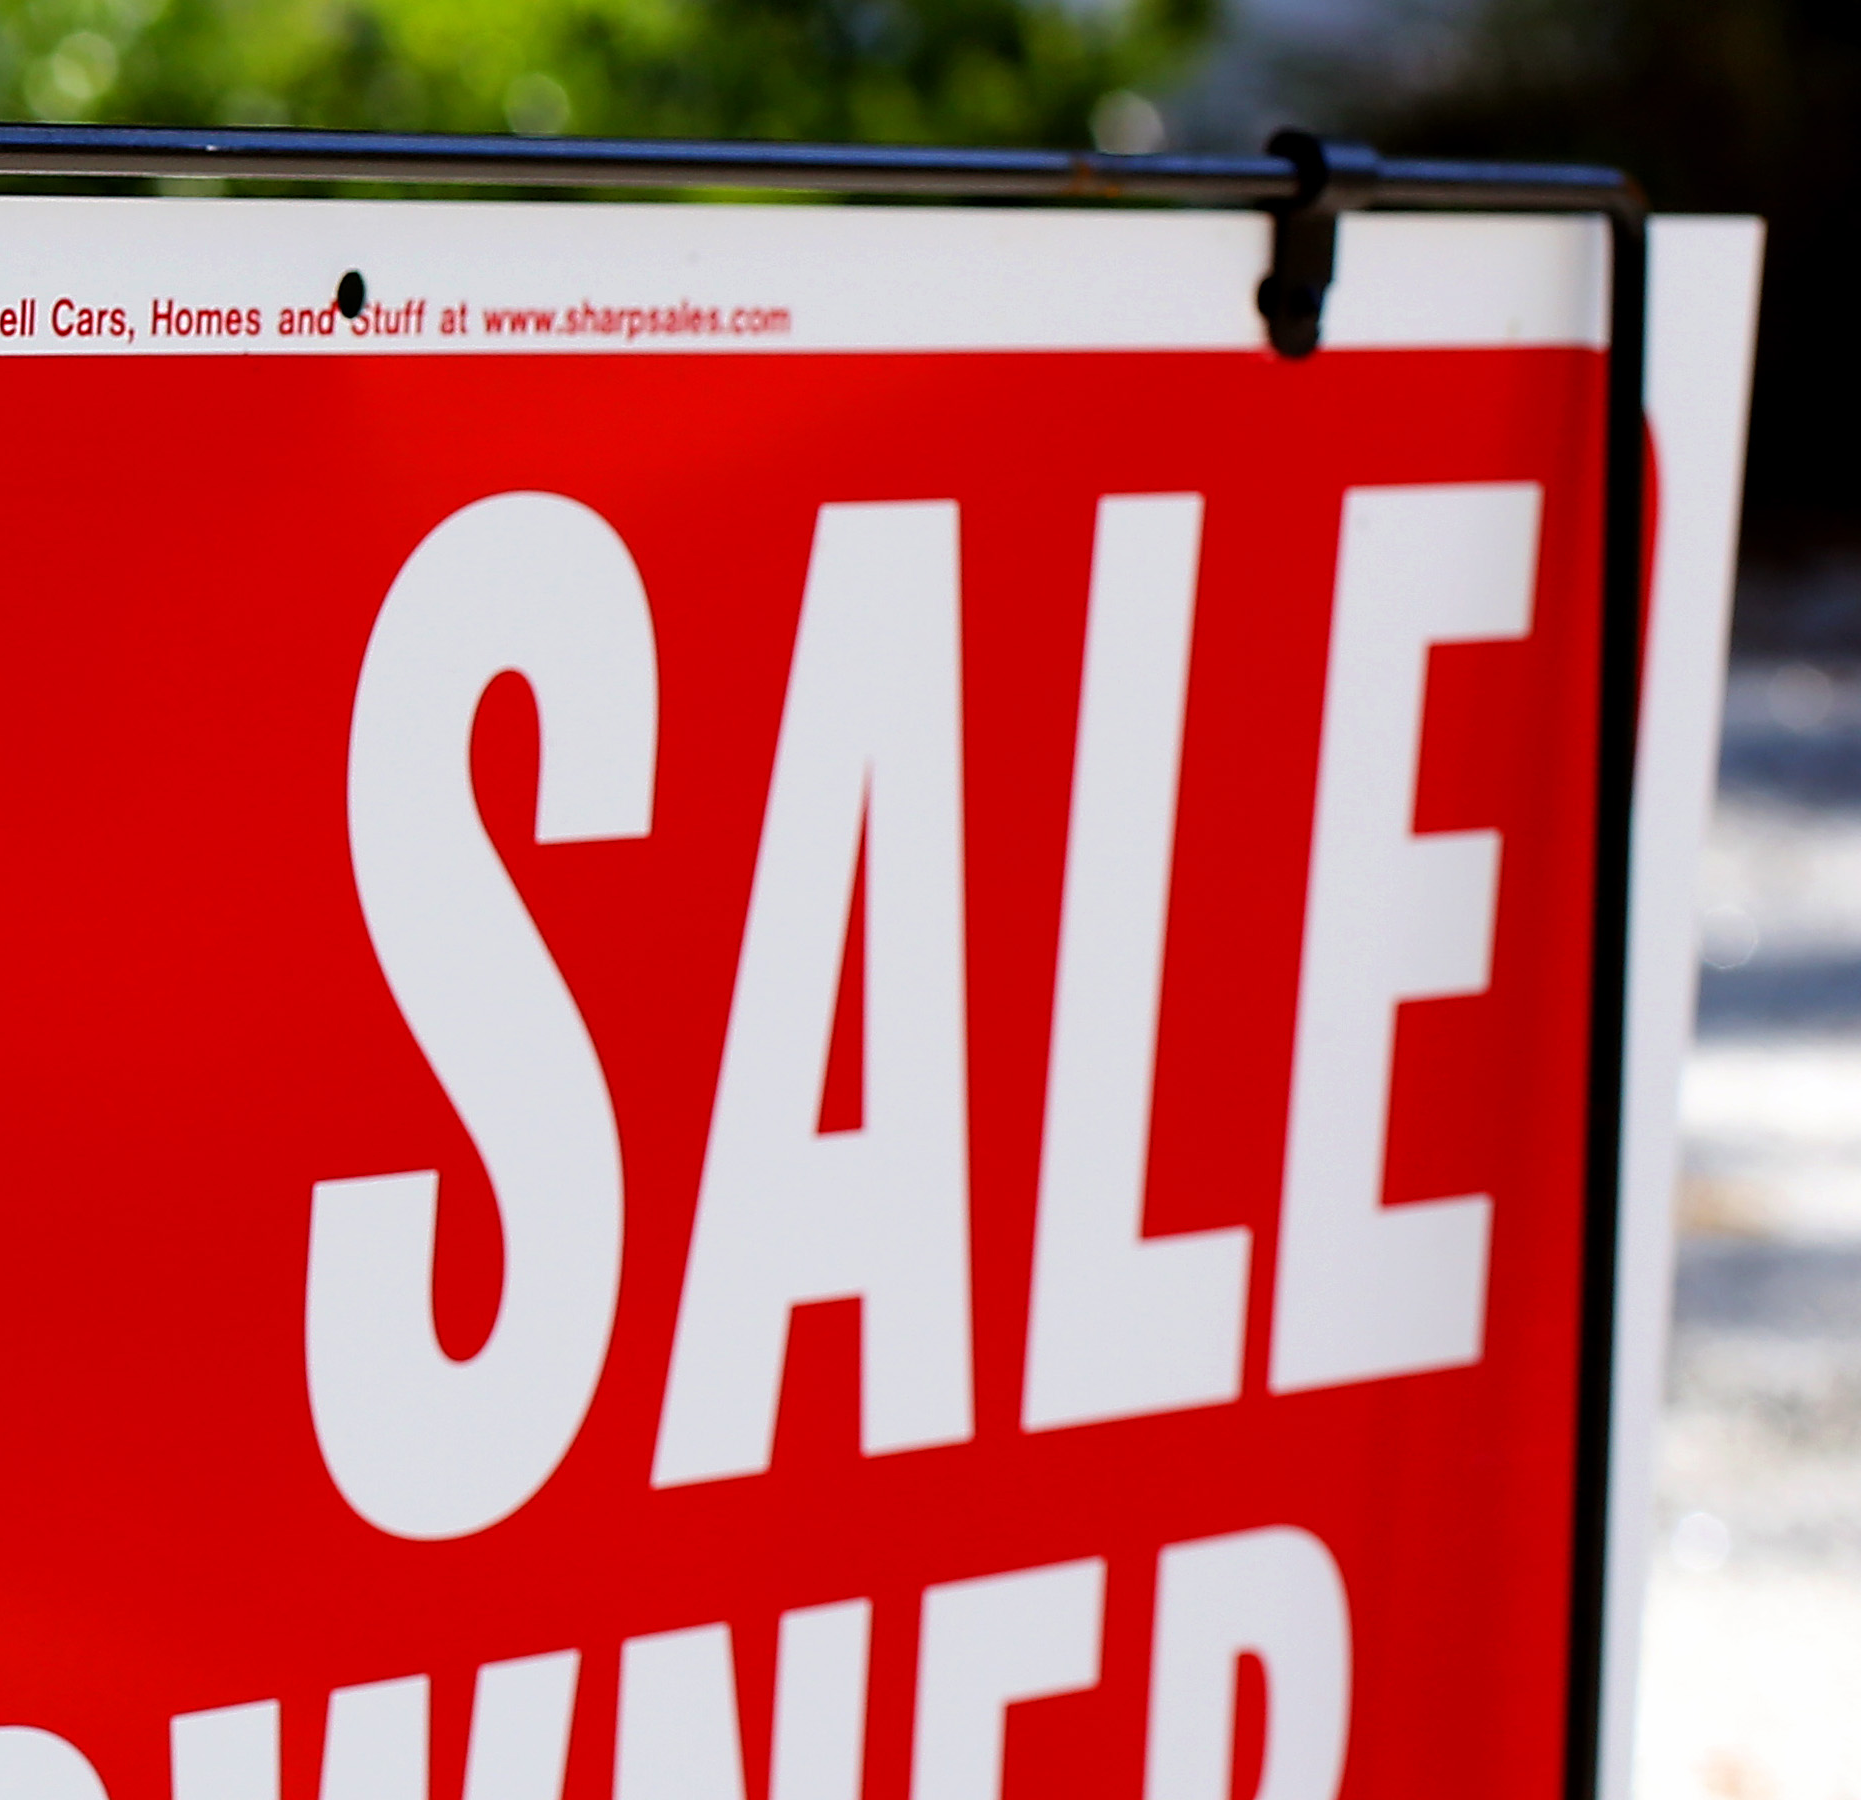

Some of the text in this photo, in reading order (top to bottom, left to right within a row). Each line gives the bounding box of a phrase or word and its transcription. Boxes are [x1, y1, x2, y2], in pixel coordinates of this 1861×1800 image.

[50, 297, 137, 344] Cars,
[150, 298, 263, 338] Homes
[277, 299, 342, 336] and
[349, 298, 426, 338] Stuff
[438, 302, 469, 337] at
[482, 301, 792, 344] www.sharpsales.com
[304, 482, 1543, 1541] SALE
